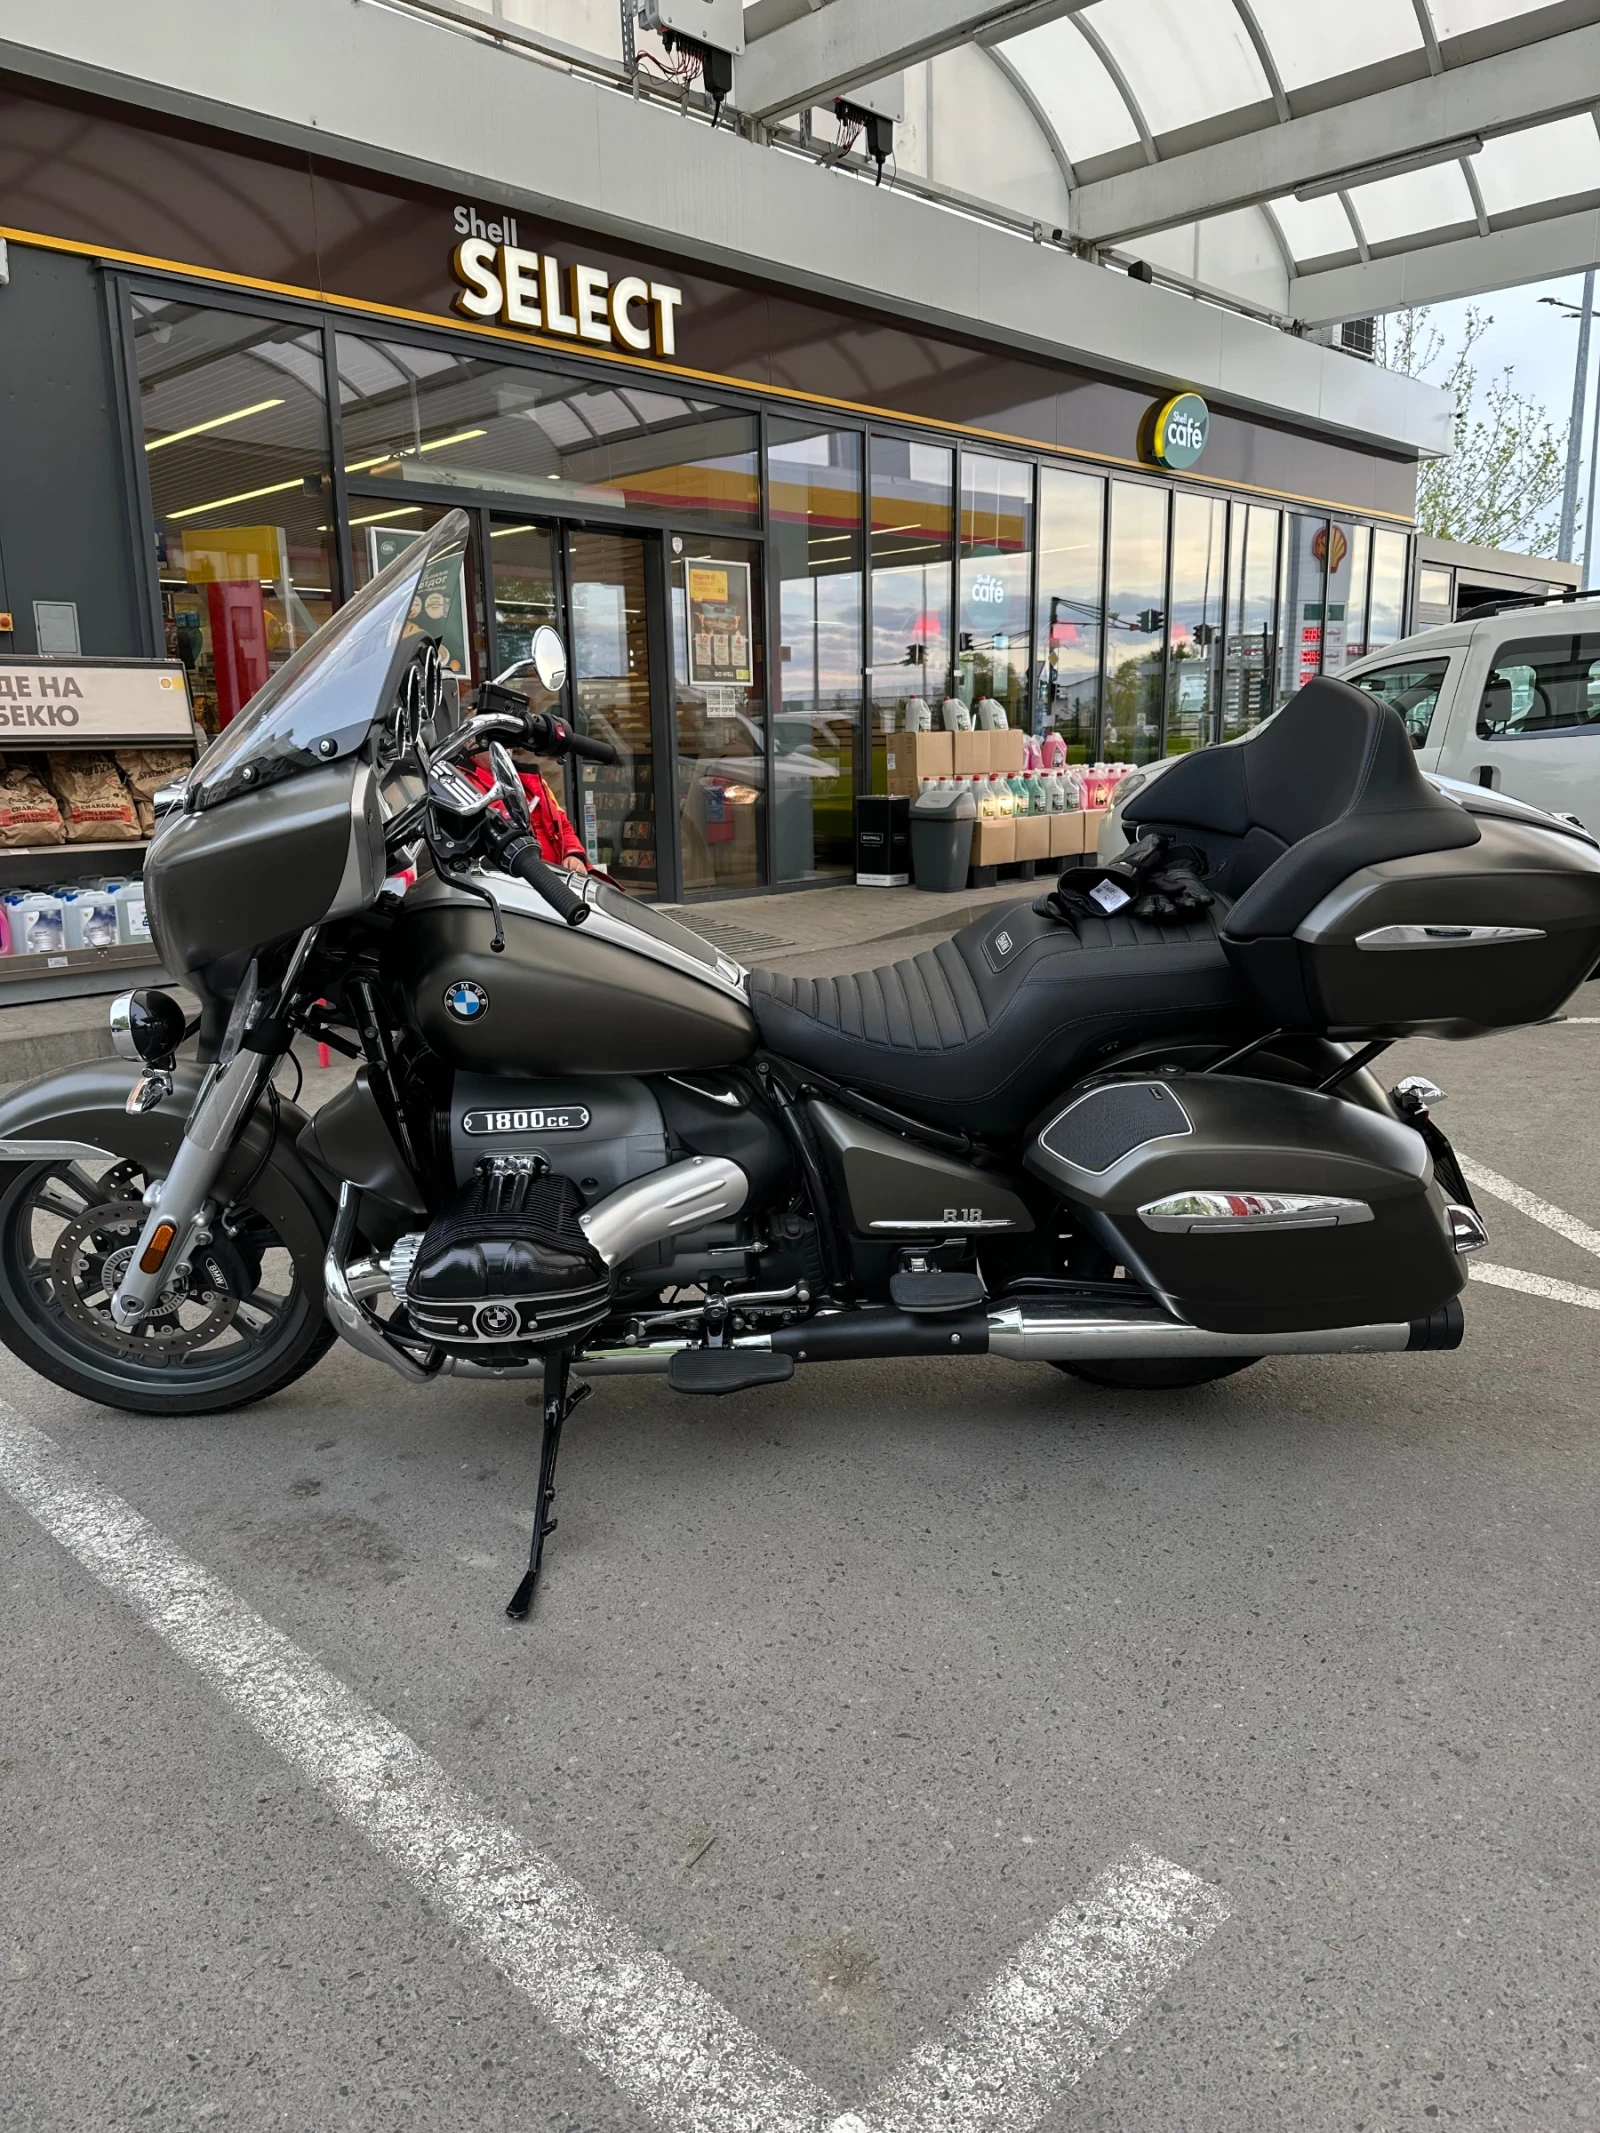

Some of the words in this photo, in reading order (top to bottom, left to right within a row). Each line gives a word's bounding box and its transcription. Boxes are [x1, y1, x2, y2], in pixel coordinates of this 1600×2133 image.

[453, 205, 518, 248] Shell
[456, 237, 682, 357] SELECT
[1173, 410, 1188, 425] Shell
[1167, 417, 1203, 450] café
[971, 578, 1004, 604] café
[0, 675, 32, 701] ДЕ
[38, 675, 84, 699] НА
[80, 802, 120, 810] CHARCOAL
[448, 983, 484, 997] BMW
[484, 1110, 569, 1131] 1800cc
[943, 1208, 958, 1223] R
[960, 1208, 983, 1223] 18
[209, 1264, 225, 1288] BMW
